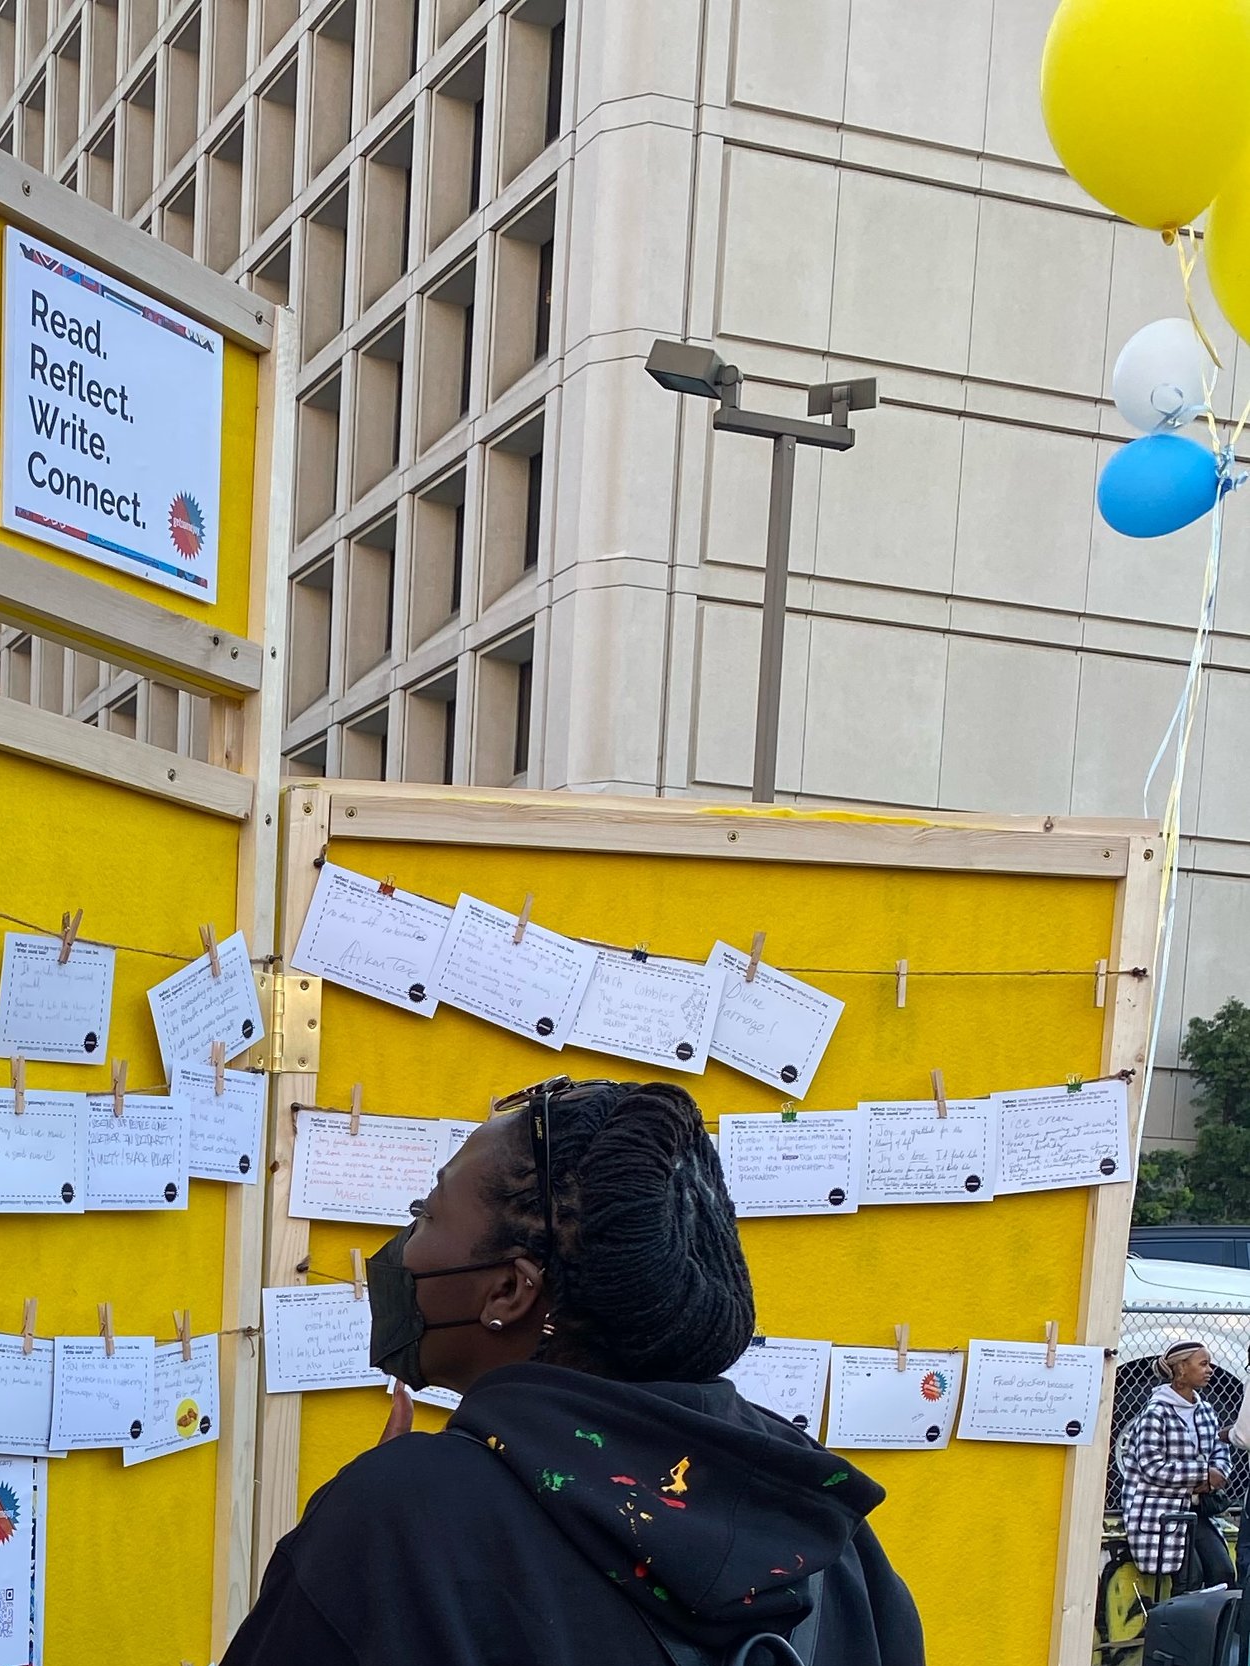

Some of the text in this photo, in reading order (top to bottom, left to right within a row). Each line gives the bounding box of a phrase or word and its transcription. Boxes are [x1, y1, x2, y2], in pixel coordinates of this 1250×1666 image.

[30, 290, 108, 359] Read.
[30, 343, 134, 423] Reflect.
[29, 395, 111, 464] Write.
[28, 452, 146, 529] Connect.
